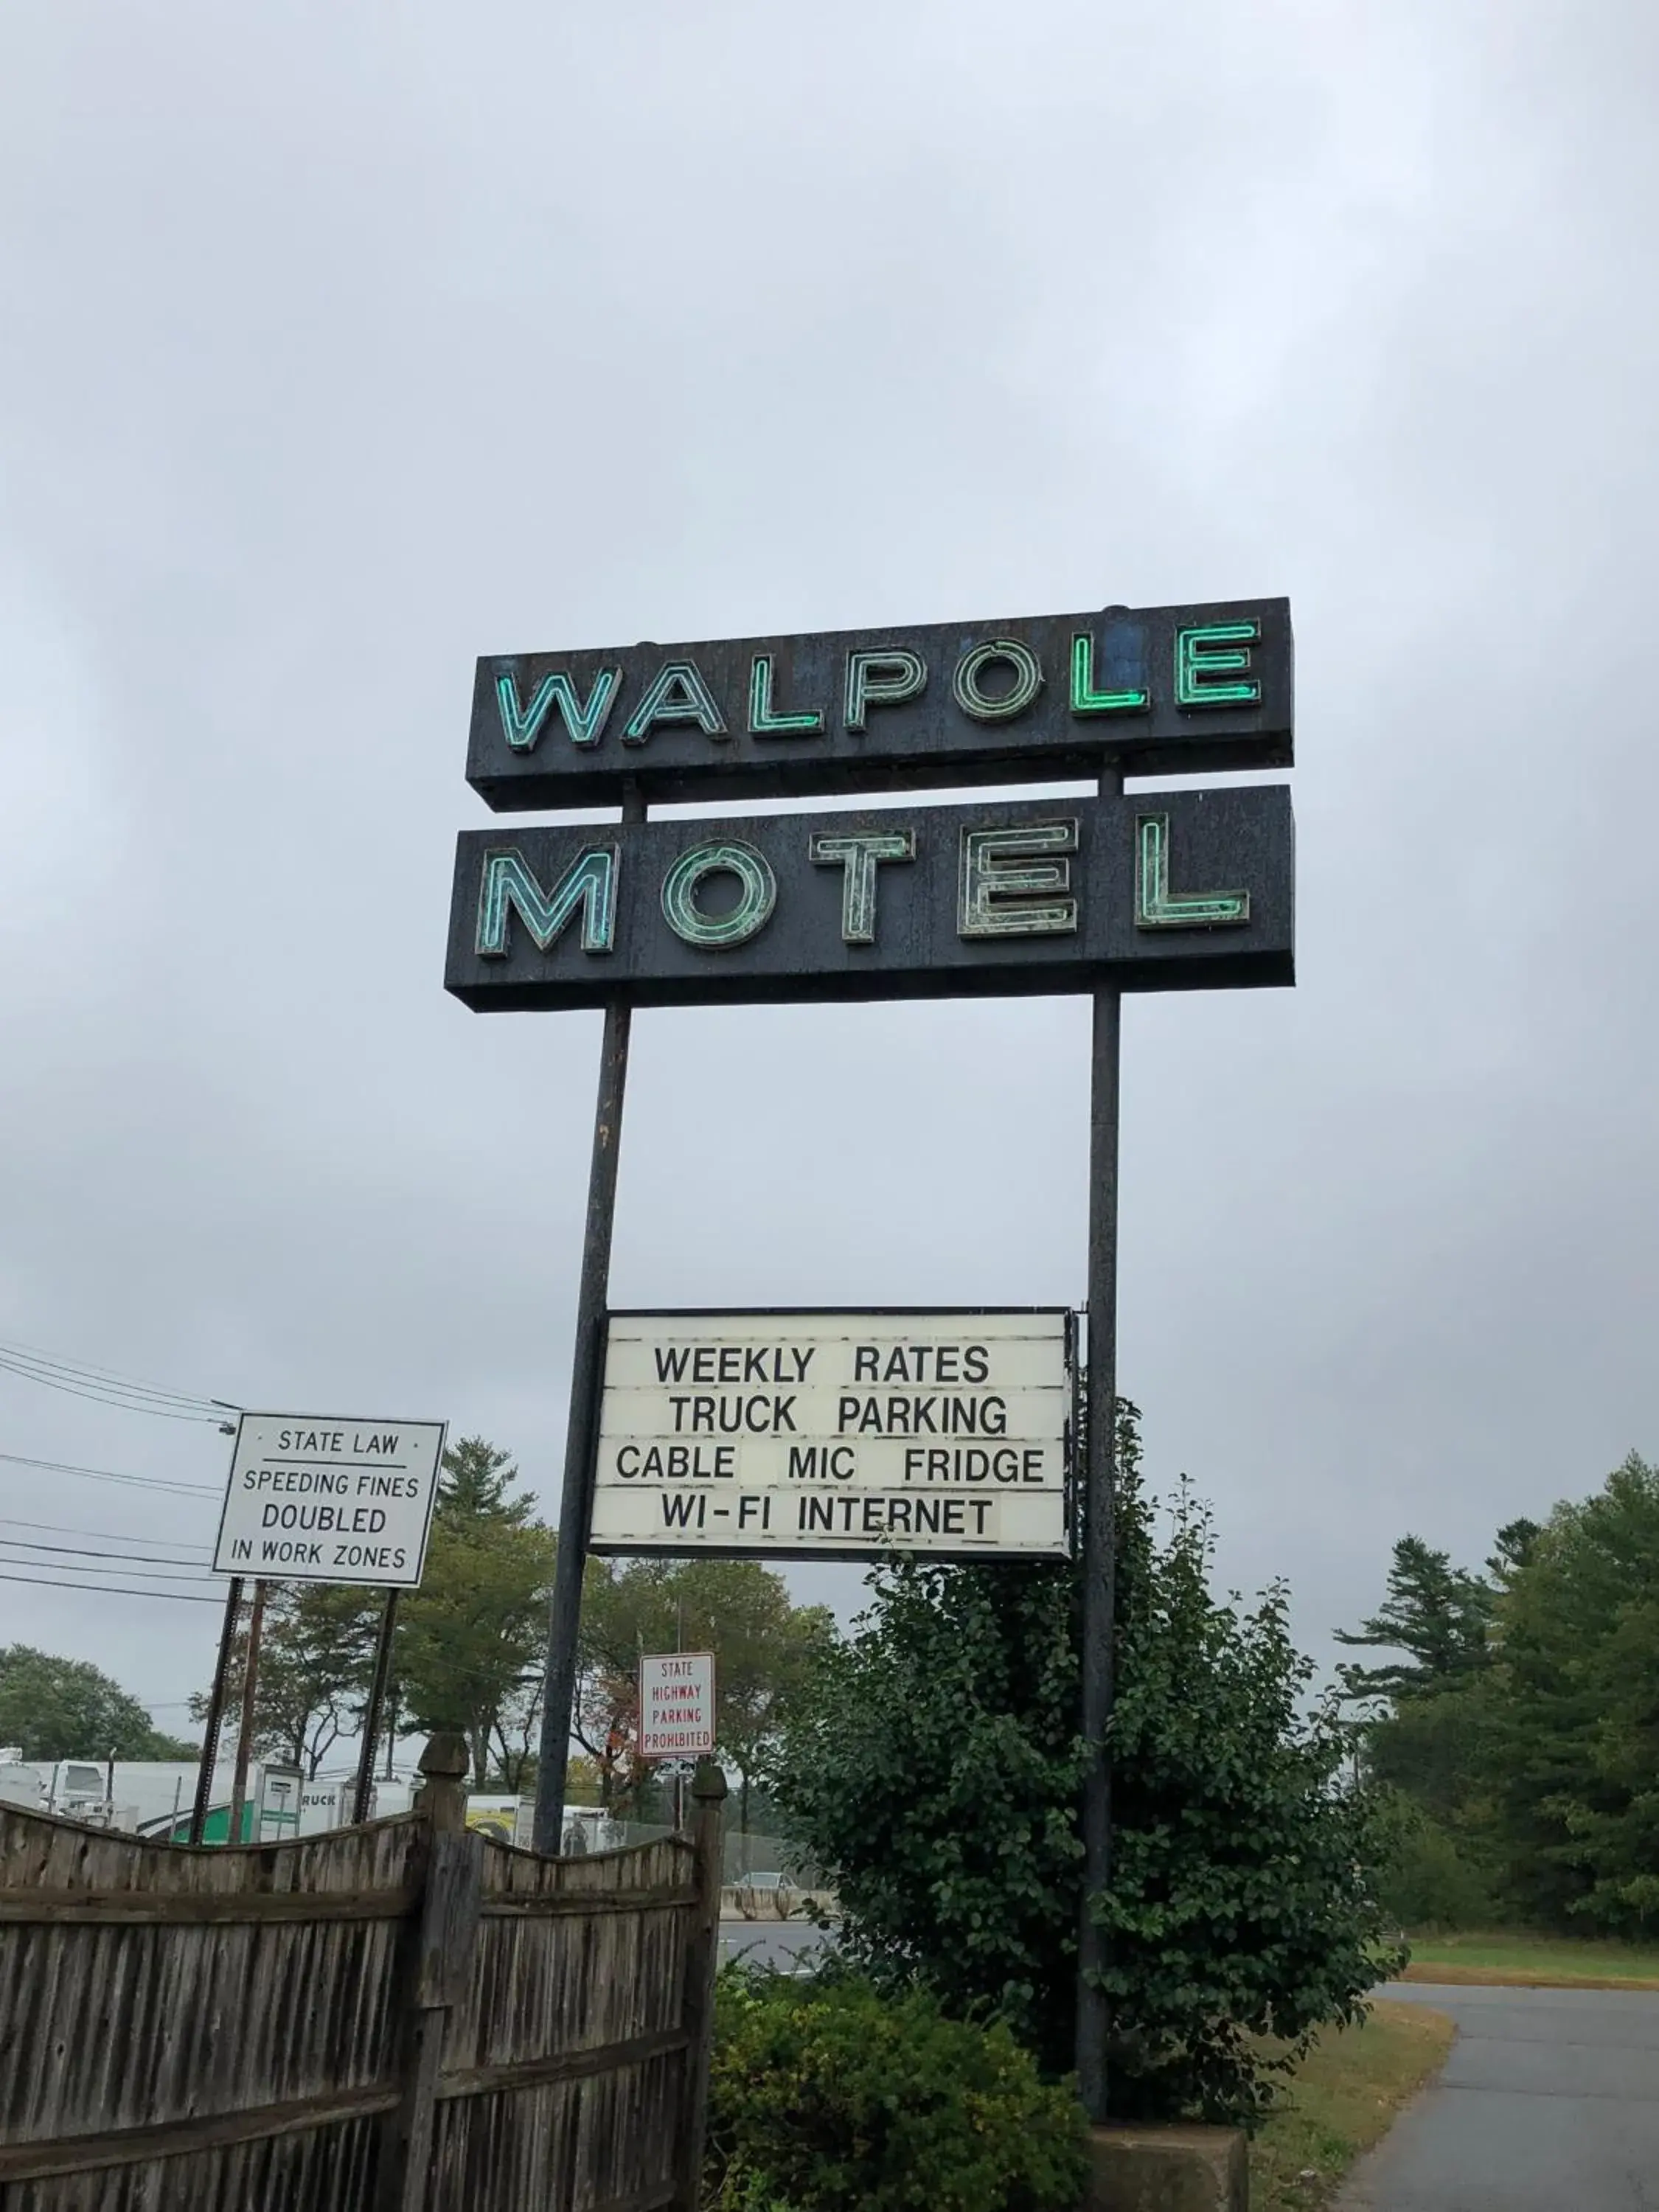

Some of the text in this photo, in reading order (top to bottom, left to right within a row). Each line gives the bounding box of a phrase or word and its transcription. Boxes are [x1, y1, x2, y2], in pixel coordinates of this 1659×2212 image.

[495, 617, 1262, 754] WALPOLE
[474, 812, 1252, 958] MOTEL
[655, 1345, 990, 1383] WEEKLY RATES
[669, 1396, 1007, 1435] TRUCK PARKING
[278, 1430, 399, 1455] STATE LAW
[616, 1445, 1045, 1484] CABLE MIC FRIDGE
[243, 1470, 420, 1498] SPEEDING FINES
[262, 1503, 386, 1534] DOUBLED
[661, 1493, 993, 1535] WI-FI INTERNET
[232, 1539, 406, 1569] IN WORK ZONES
[661, 1661, 693, 1677] STATE
[652, 1684, 701, 1702] HIGHWAY
[653, 1708, 701, 1725] PARKING
[644, 1731, 710, 1748] PROHIBITED
[302, 1795, 335, 1806] RUCK
